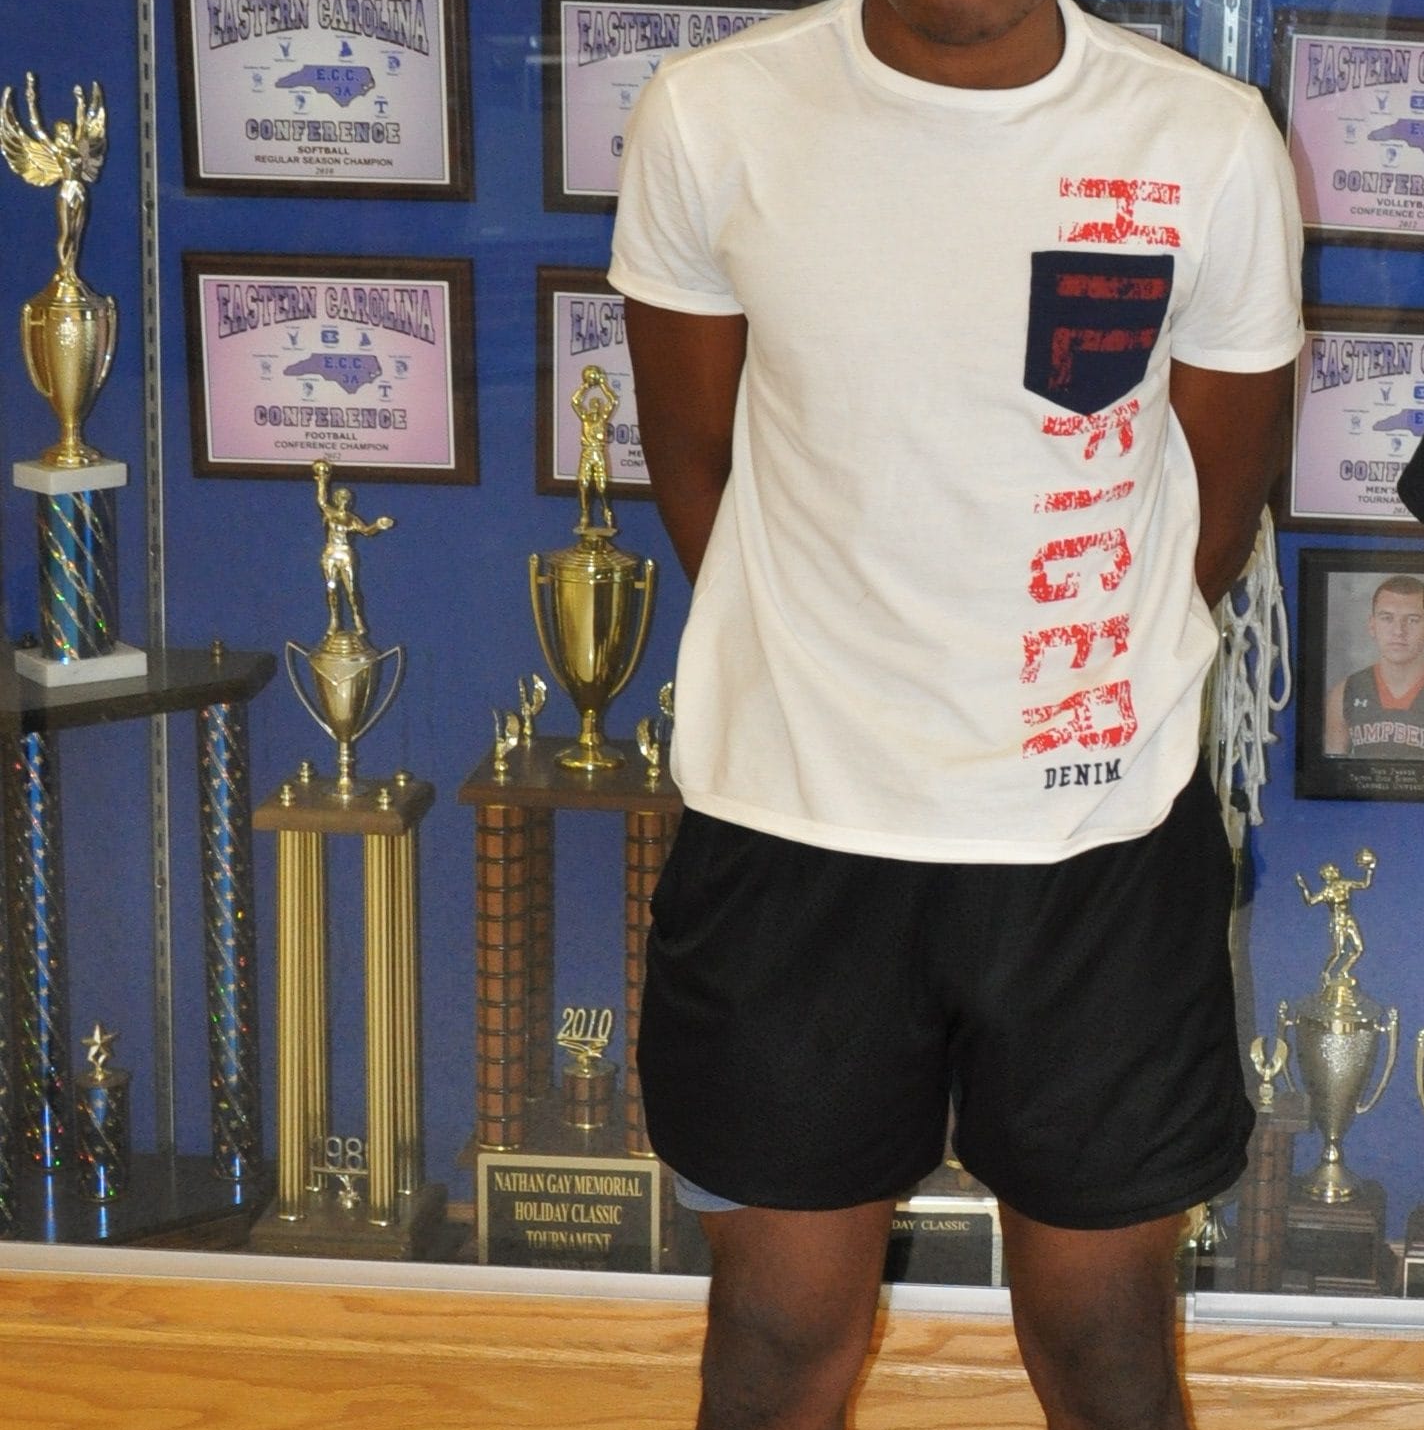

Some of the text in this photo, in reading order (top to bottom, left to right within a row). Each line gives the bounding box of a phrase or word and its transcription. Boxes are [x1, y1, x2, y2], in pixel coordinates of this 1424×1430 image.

[578, 10, 680, 67] EASTERN
[1306, 43, 1411, 100] EASTERN
[246, 119, 400, 143] CONFERENCE
[255, 155, 393, 167] REGULAR SEASON CHAMPION
[298, 146, 350, 155] SOFTBALL
[1350, 207, 1414, 218] CONFERENCE
[216, 285, 435, 345] EASTERN CAROLINA
[1311, 339, 1413, 393] EASTERN
[254, 406, 407, 429] CONFERENCE
[274, 441, 389, 451] CONFERENCE CHAMPION
[305, 432, 357, 441] FOOTBALL
[1044, 759, 1122, 789] DENIM
[557, 1008, 614, 1040] 2010
[495, 1172, 642, 1197] NATHAN GAY MEMORIAL
[515, 1203, 622, 1225] HOLIDAY CLASSIC
[921, 1221, 970, 1231] CLASSIC
[525, 1230, 612, 1253] TOURNAMENT
